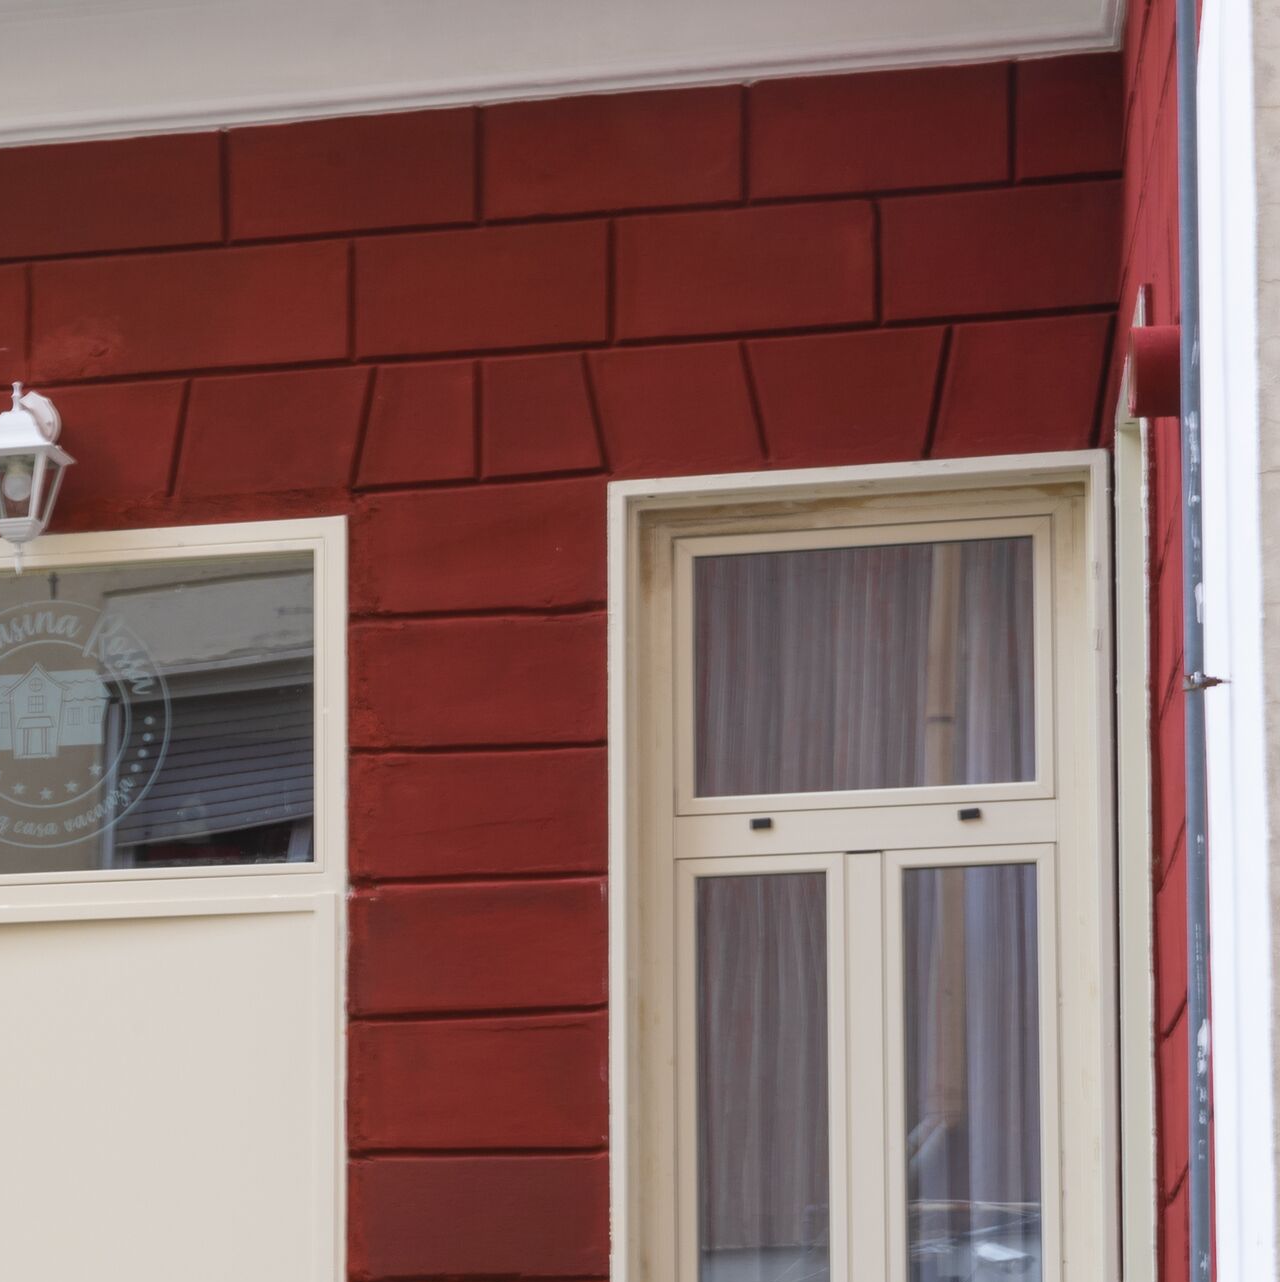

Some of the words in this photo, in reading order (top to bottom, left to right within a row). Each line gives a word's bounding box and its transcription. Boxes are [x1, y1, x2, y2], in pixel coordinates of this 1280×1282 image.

[81, 613, 156, 696] Rossa
[13, 820, 59, 837] casa
[63, 777, 137, 833] vacanza
